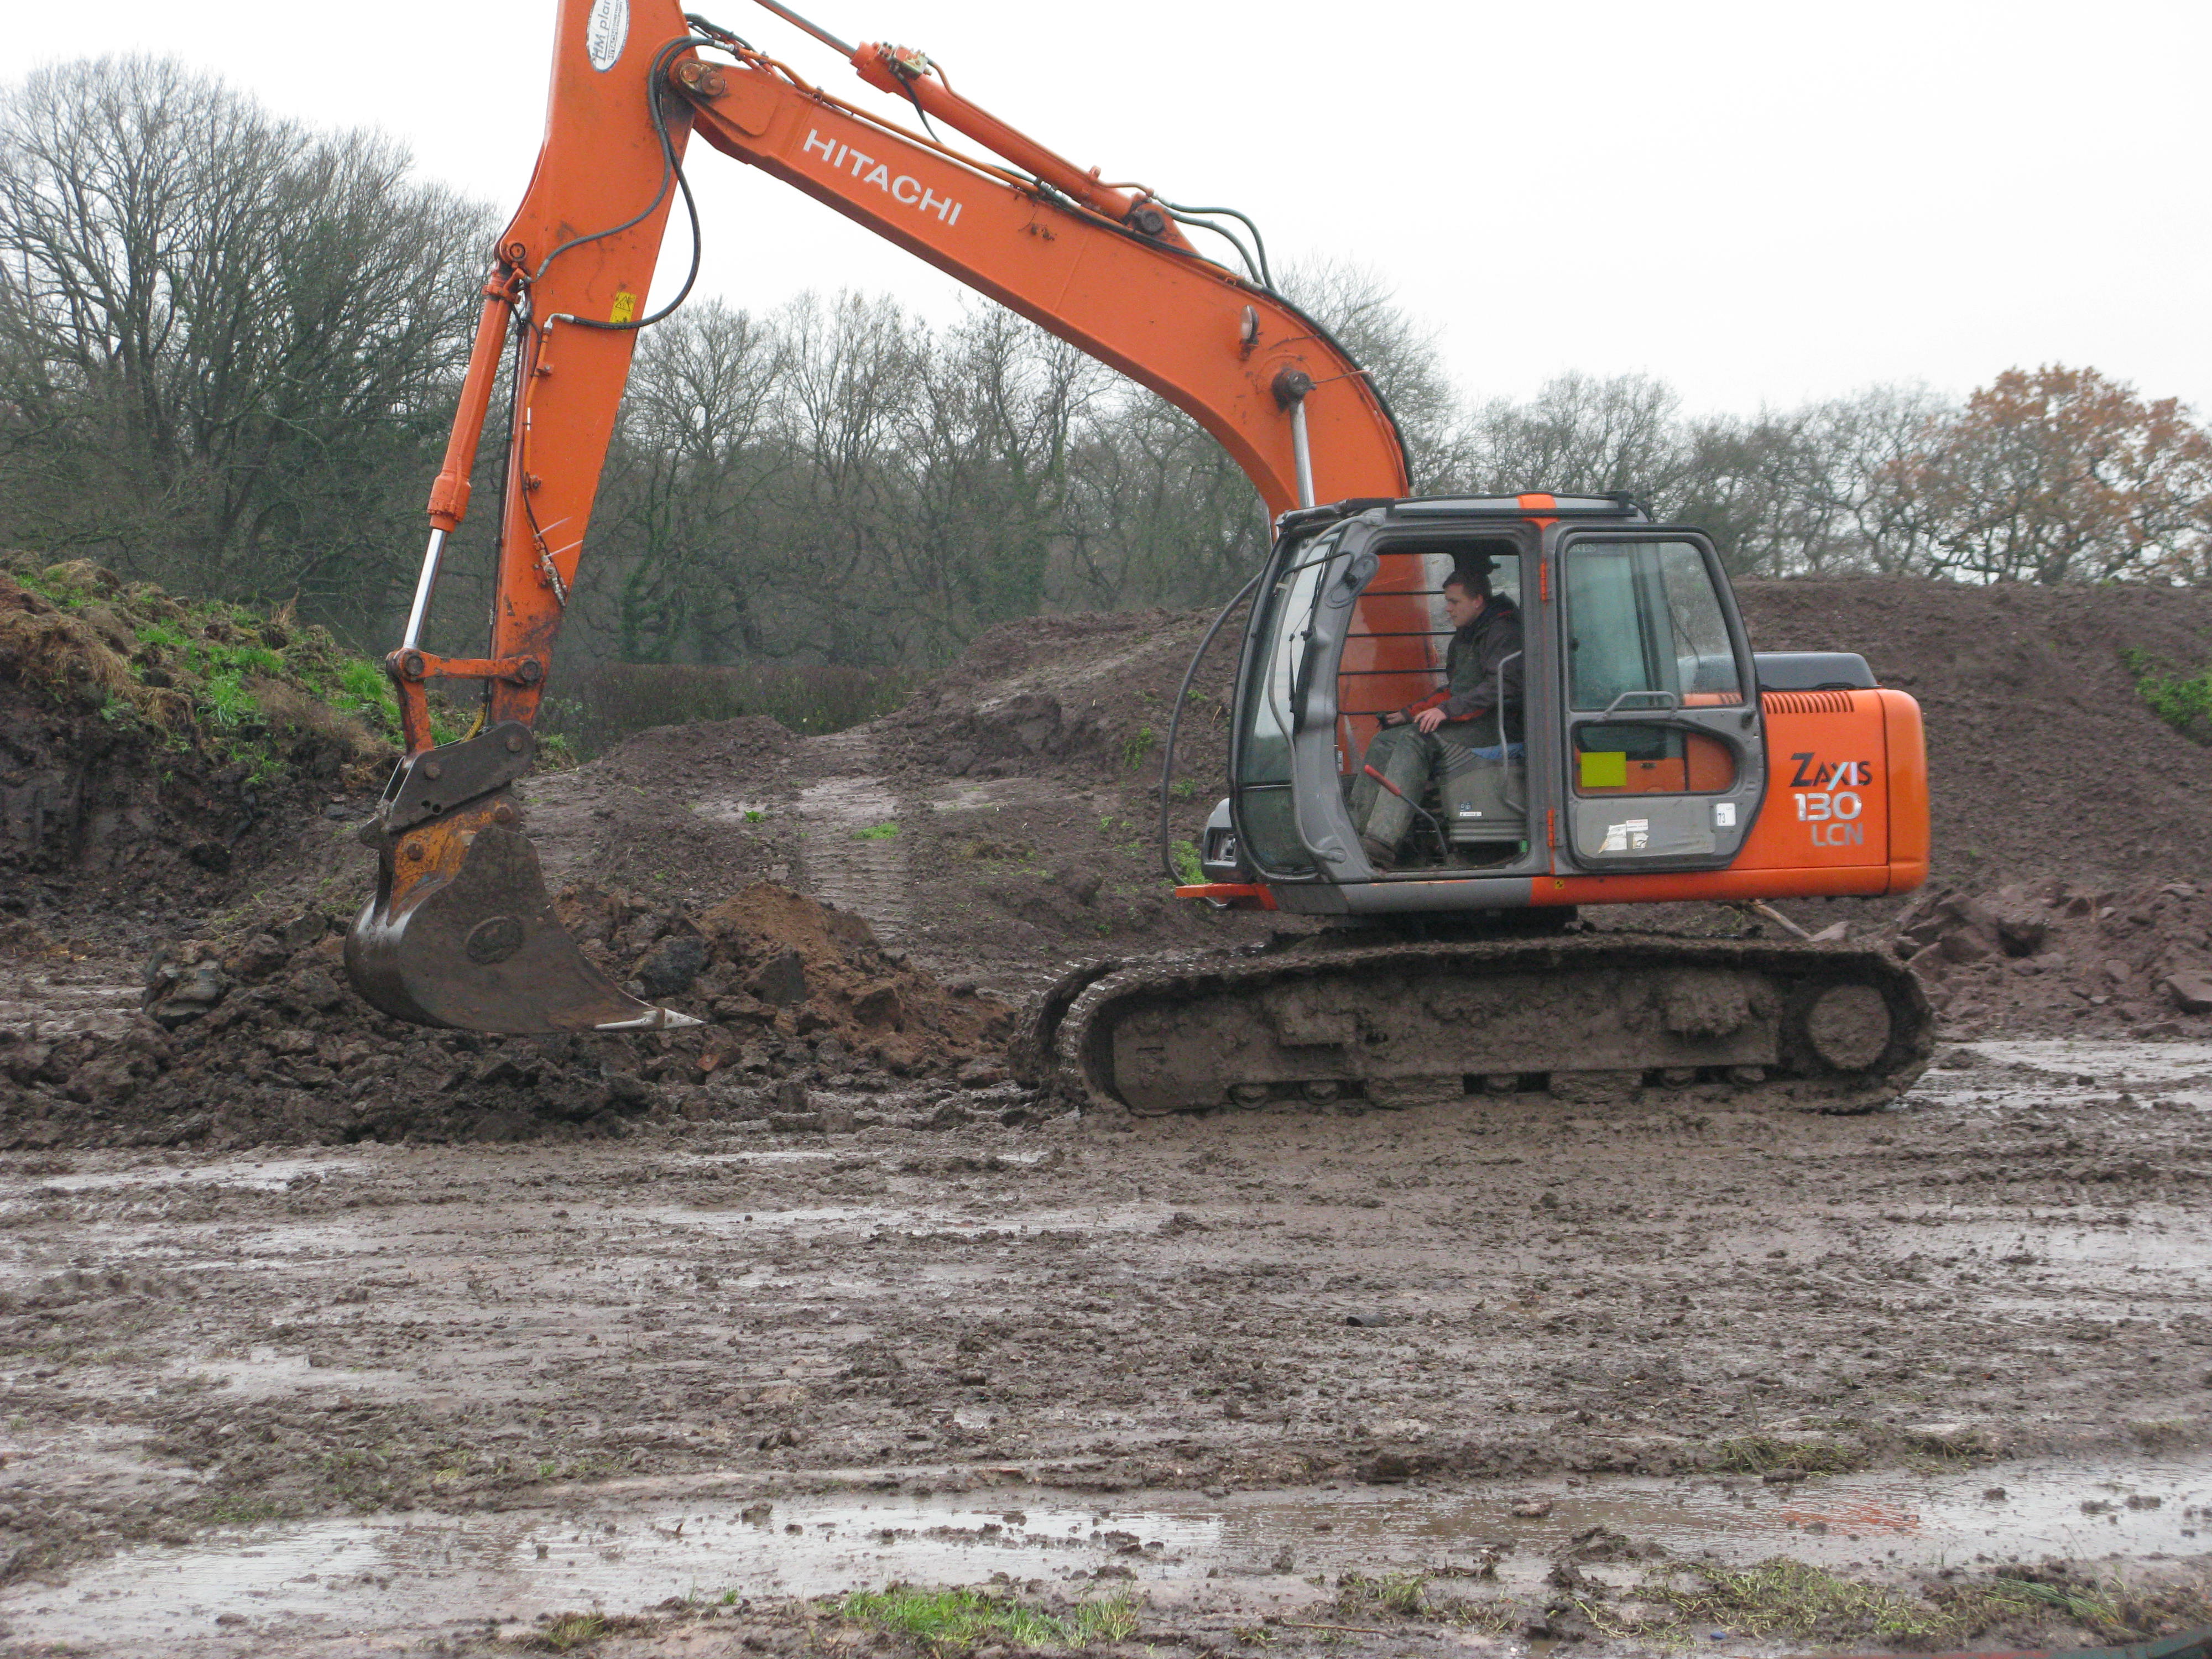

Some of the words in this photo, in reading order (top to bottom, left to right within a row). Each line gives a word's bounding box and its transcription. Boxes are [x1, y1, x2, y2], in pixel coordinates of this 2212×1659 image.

[607, 27, 618, 60] HITACHI
[803, 128, 962, 226] HITACHI
[1790, 752, 1872, 791] ZAXIS
[1793, 791, 1863, 821] 130
[1811, 822, 1864, 847] LCN
